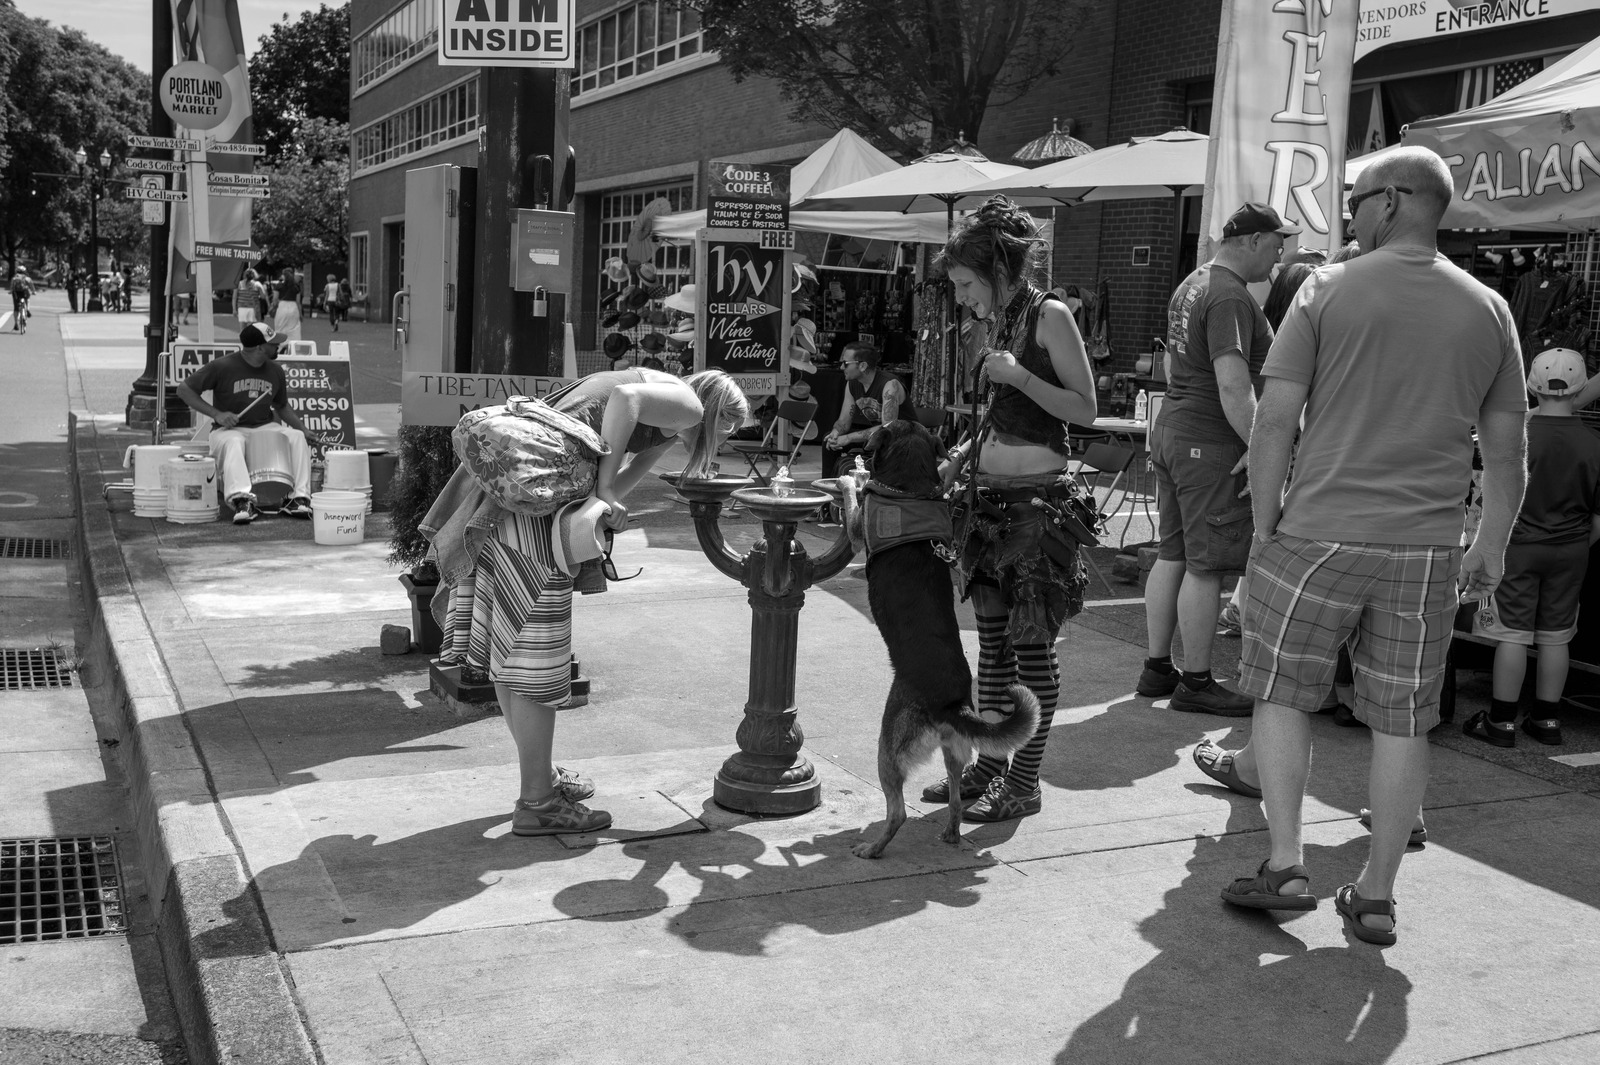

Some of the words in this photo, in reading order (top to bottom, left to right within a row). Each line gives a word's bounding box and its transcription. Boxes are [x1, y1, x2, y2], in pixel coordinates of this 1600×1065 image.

[1358, 0, 1427, 24] VENDORS
[1434, 0, 1550, 32] ENTRANCE
[451, 28, 563, 52] INSIDE
[1357, 25, 1392, 42] SIDE
[170, 77, 222, 99] PORTLAND
[175, 94, 215, 106] WORLD
[172, 103, 218, 115] MARKET
[135, 137, 150, 146] New
[153, 138, 170, 147] York
[170, 140, 187, 149] 2437
[187, 141, 198, 149] mi
[212, 145, 228, 154] okyo
[248, 145, 258, 153] mi
[126, 159, 148, 168] Code
[148, 160, 154, 169] 3
[154, 161, 183, 171] Coffee
[1441, 140, 1600, 201] ALIAN
[208, 172, 233, 183] Cosas
[234, 175, 261, 184] Bonita
[725, 169, 761, 181] CODE
[763, 171, 770, 182] 3
[127, 188, 144, 198] HV
[147, 190, 183, 200] Cellars
[725, 182, 771, 194] COFFEE
[714, 201, 753, 210] ESPRESSO
[755, 203, 782, 211] DRINKS
[713, 210, 739, 218] ITALIAN
[754, 211, 763, 219] &
[765, 212, 783, 220] SODA
[710, 219, 740, 227] COOKIES
[741, 219, 750, 227] &
[752, 220, 786, 229] PASTRIES
[762, 231, 793, 248] FREE
[196, 245, 213, 256] FREE
[214, 246, 232, 258] WINE
[233, 249, 262, 260] TASTING
[710, 245, 774, 297] hv
[709, 303, 767, 315] CELLARS
[709, 316, 754, 340] Wine
[725, 338, 777, 367] Tasting
[285, 368, 316, 378] ODE
[319, 368, 326, 378] 3
[419, 375, 527, 400] TIBETAN
[288, 397, 349, 411] presso
[300, 413, 342, 431] inks
[336, 525, 358, 535] Fund
